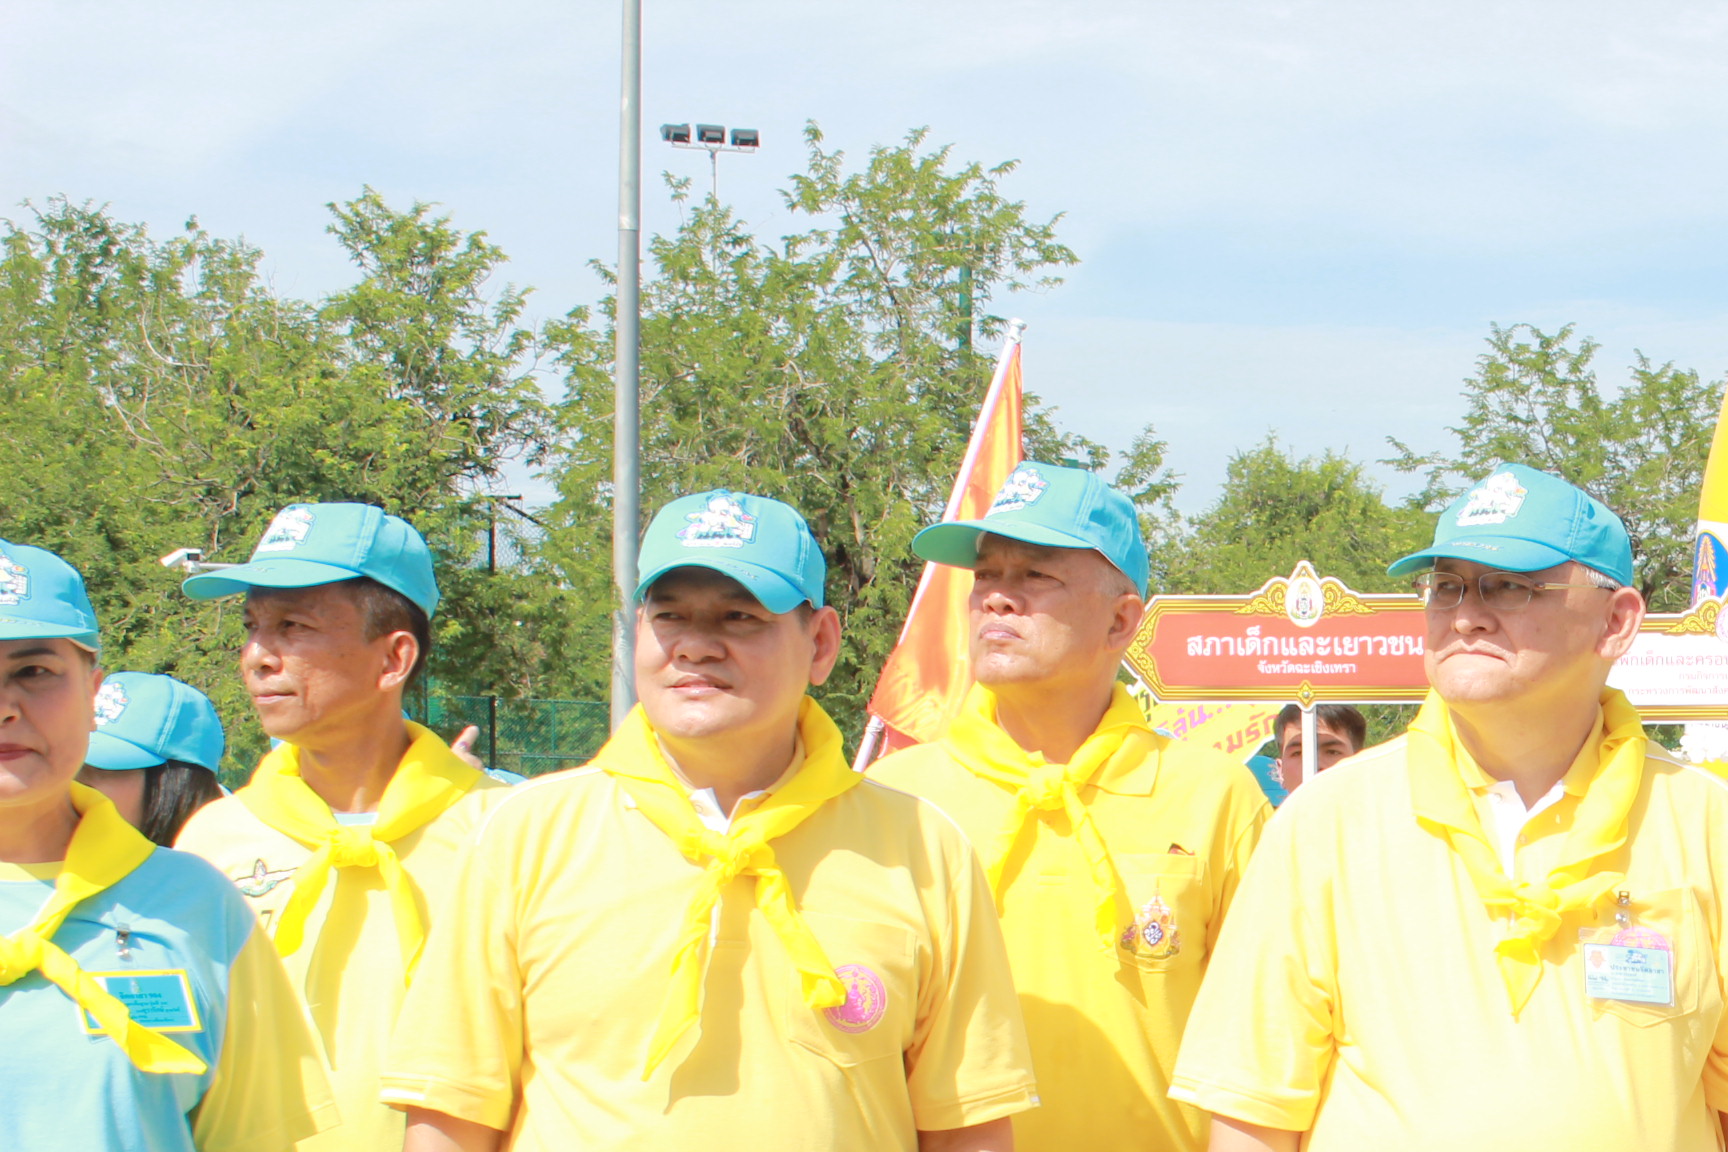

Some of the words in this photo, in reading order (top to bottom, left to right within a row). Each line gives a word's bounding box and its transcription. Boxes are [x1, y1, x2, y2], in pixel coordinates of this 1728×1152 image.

[1186, 625, 1425, 658] สภาเด็กและเยาวชน
[1257, 659, 1357, 675] จังหวัดฉะเชิงเทรา
